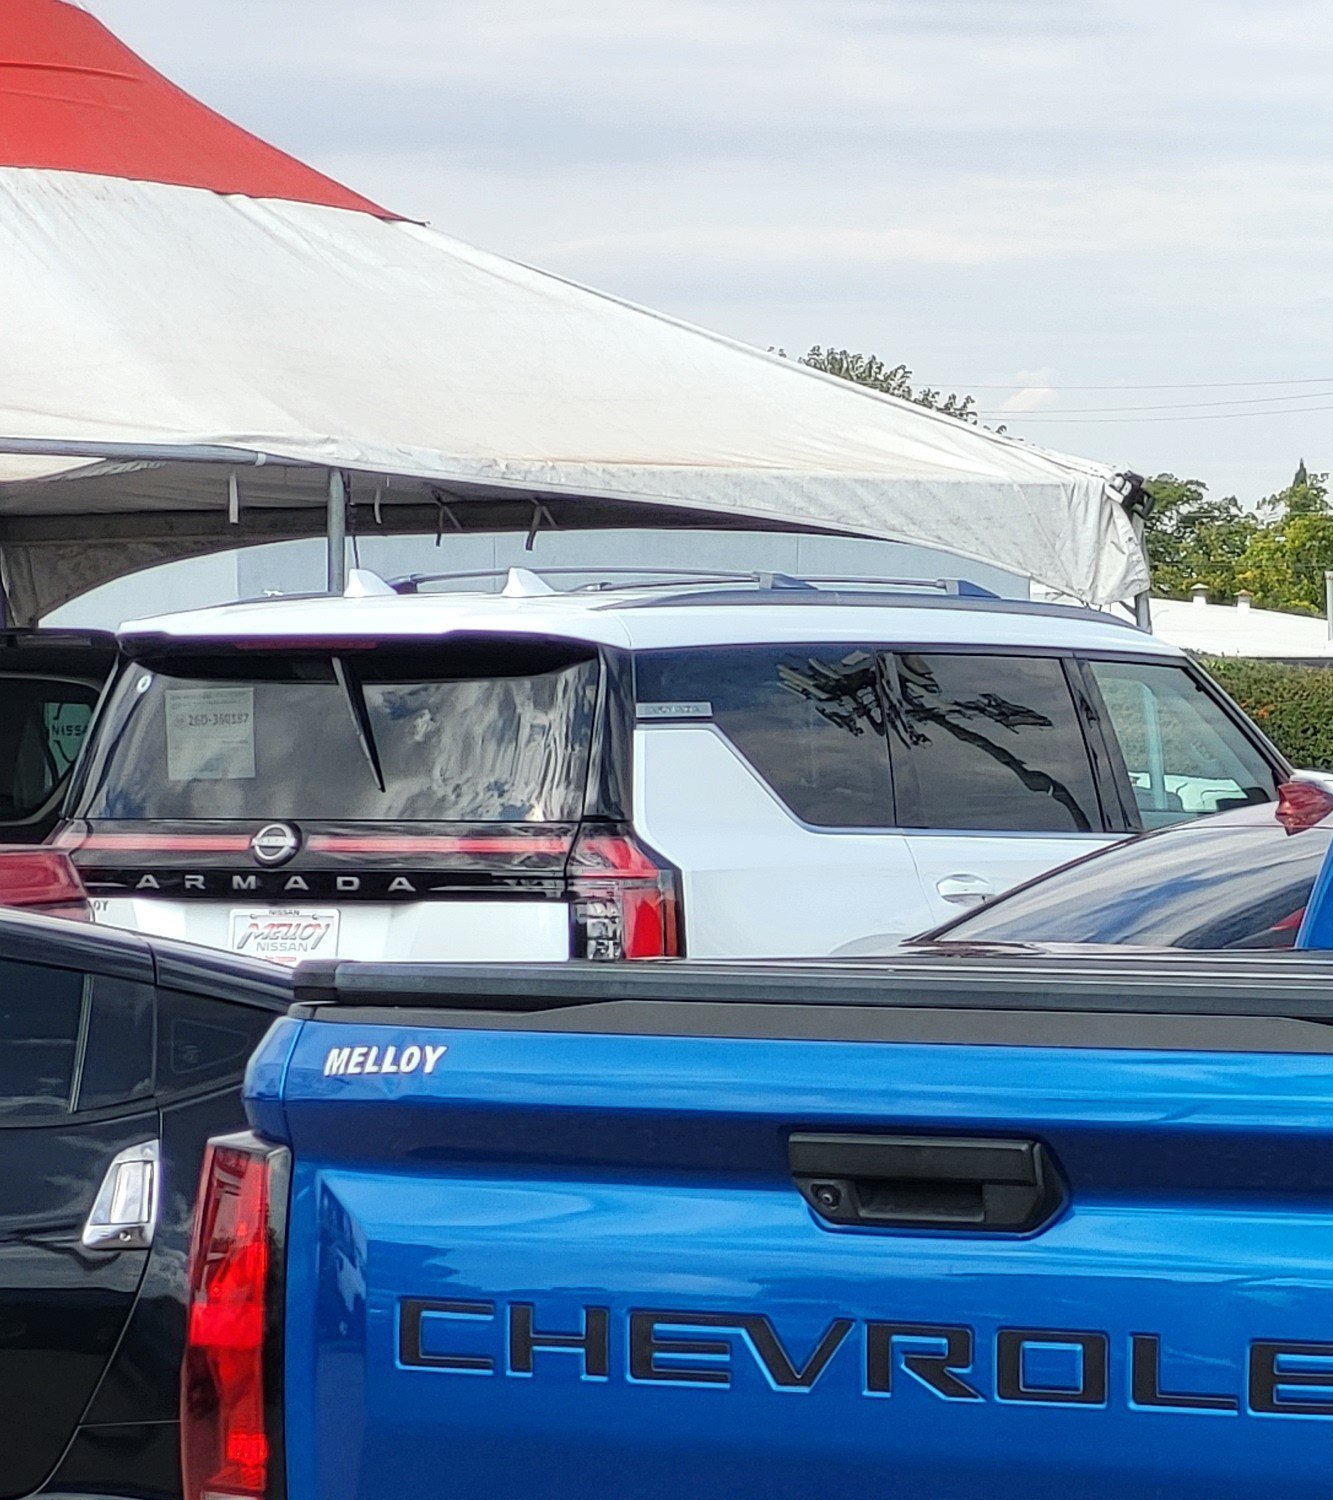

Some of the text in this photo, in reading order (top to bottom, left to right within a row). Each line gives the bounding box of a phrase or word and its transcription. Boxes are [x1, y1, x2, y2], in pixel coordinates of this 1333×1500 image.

[135, 874, 416, 892] ARMADA
[237, 922, 331, 950] MELLOY
[256, 942, 308, 952] NISSAN
[323, 1045, 448, 1077] MELLOY
